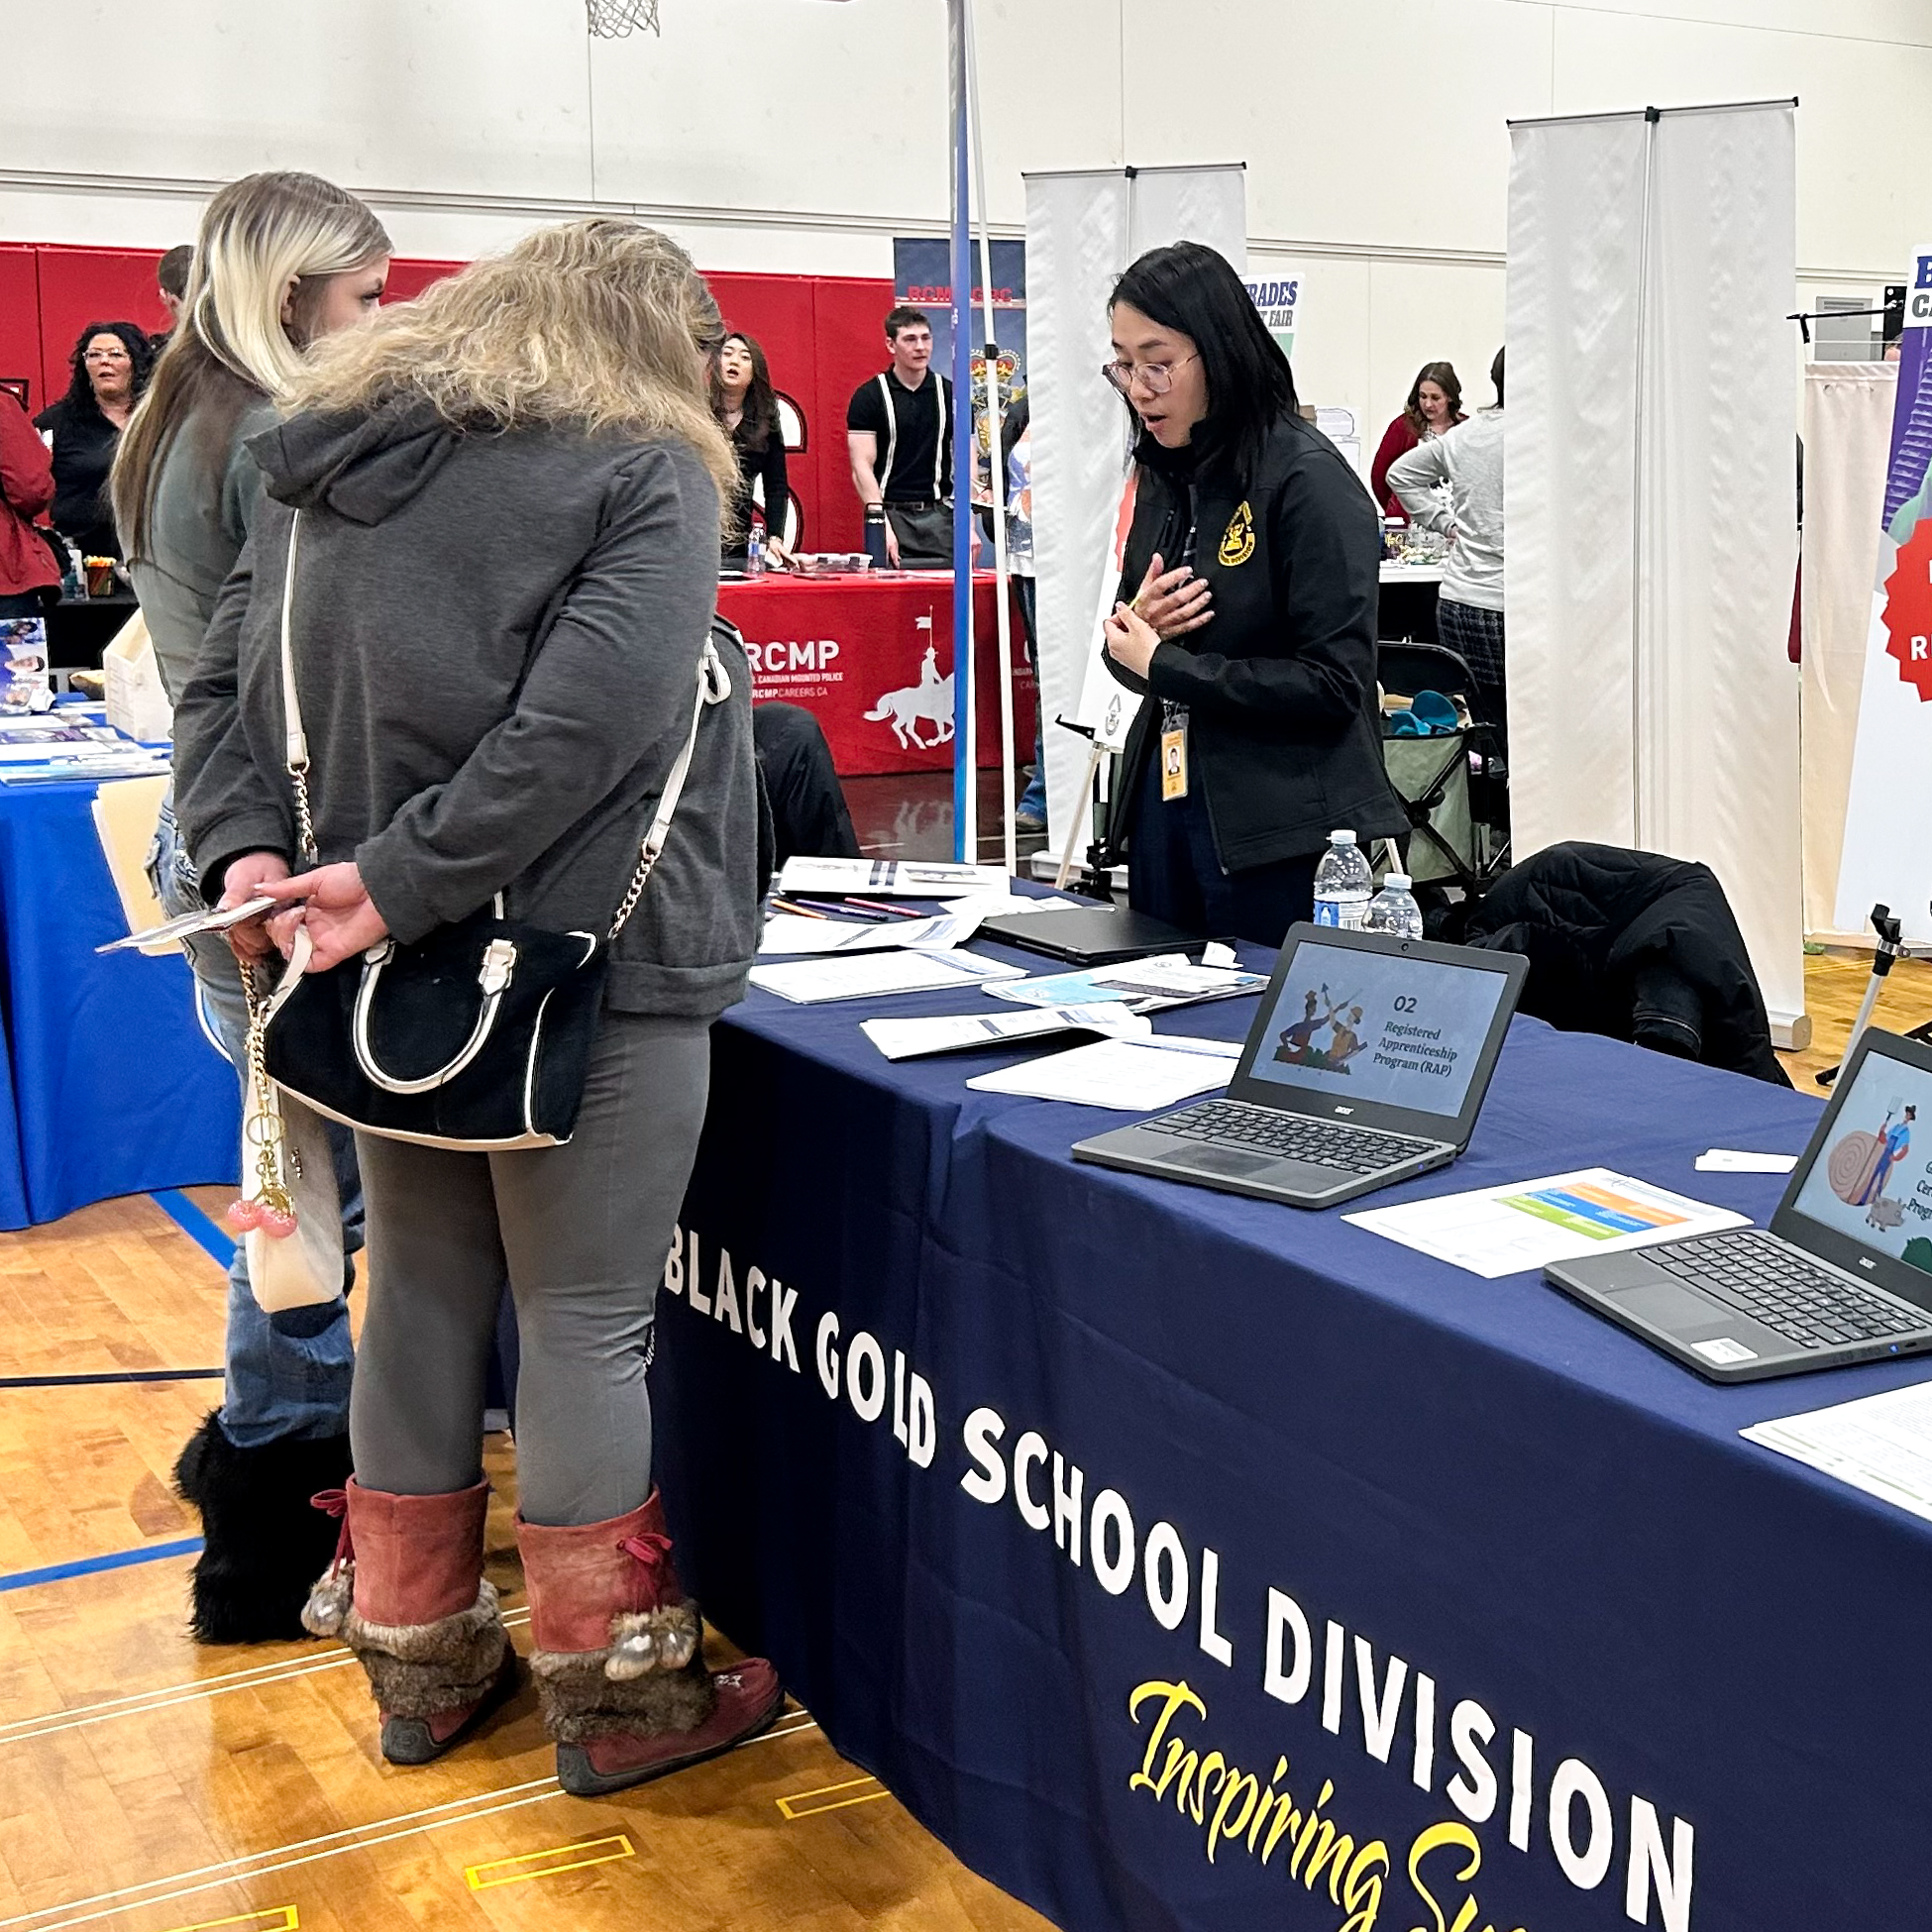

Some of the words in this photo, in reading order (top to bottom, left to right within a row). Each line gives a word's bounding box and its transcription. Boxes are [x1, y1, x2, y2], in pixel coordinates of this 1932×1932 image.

[908, 285, 953, 301] RCM
[1268, 310, 1293, 327] FAIR
[1912, 294, 1932, 318] C
[745, 640, 840, 672] RCMP
[1910, 635, 1932, 661] R
[821, 672, 843, 682] POLICE
[1393, 995, 1418, 1014] 02
[1384, 1020, 1442, 1040] Registered
[1378, 1036, 1457, 1063] Apprenticeship
[1372, 1052, 1420, 1069] Program
[1420, 1060, 1452, 1078] (RAP)
[664, 1222, 802, 1374] BLACK
[815, 1310, 936, 1469] GOLD
[960, 1407, 1233, 1667] SCHOOL
[1263, 1586, 1694, 1932] DIVISION
[1128, 1679, 1391, 1932] Inspiring
